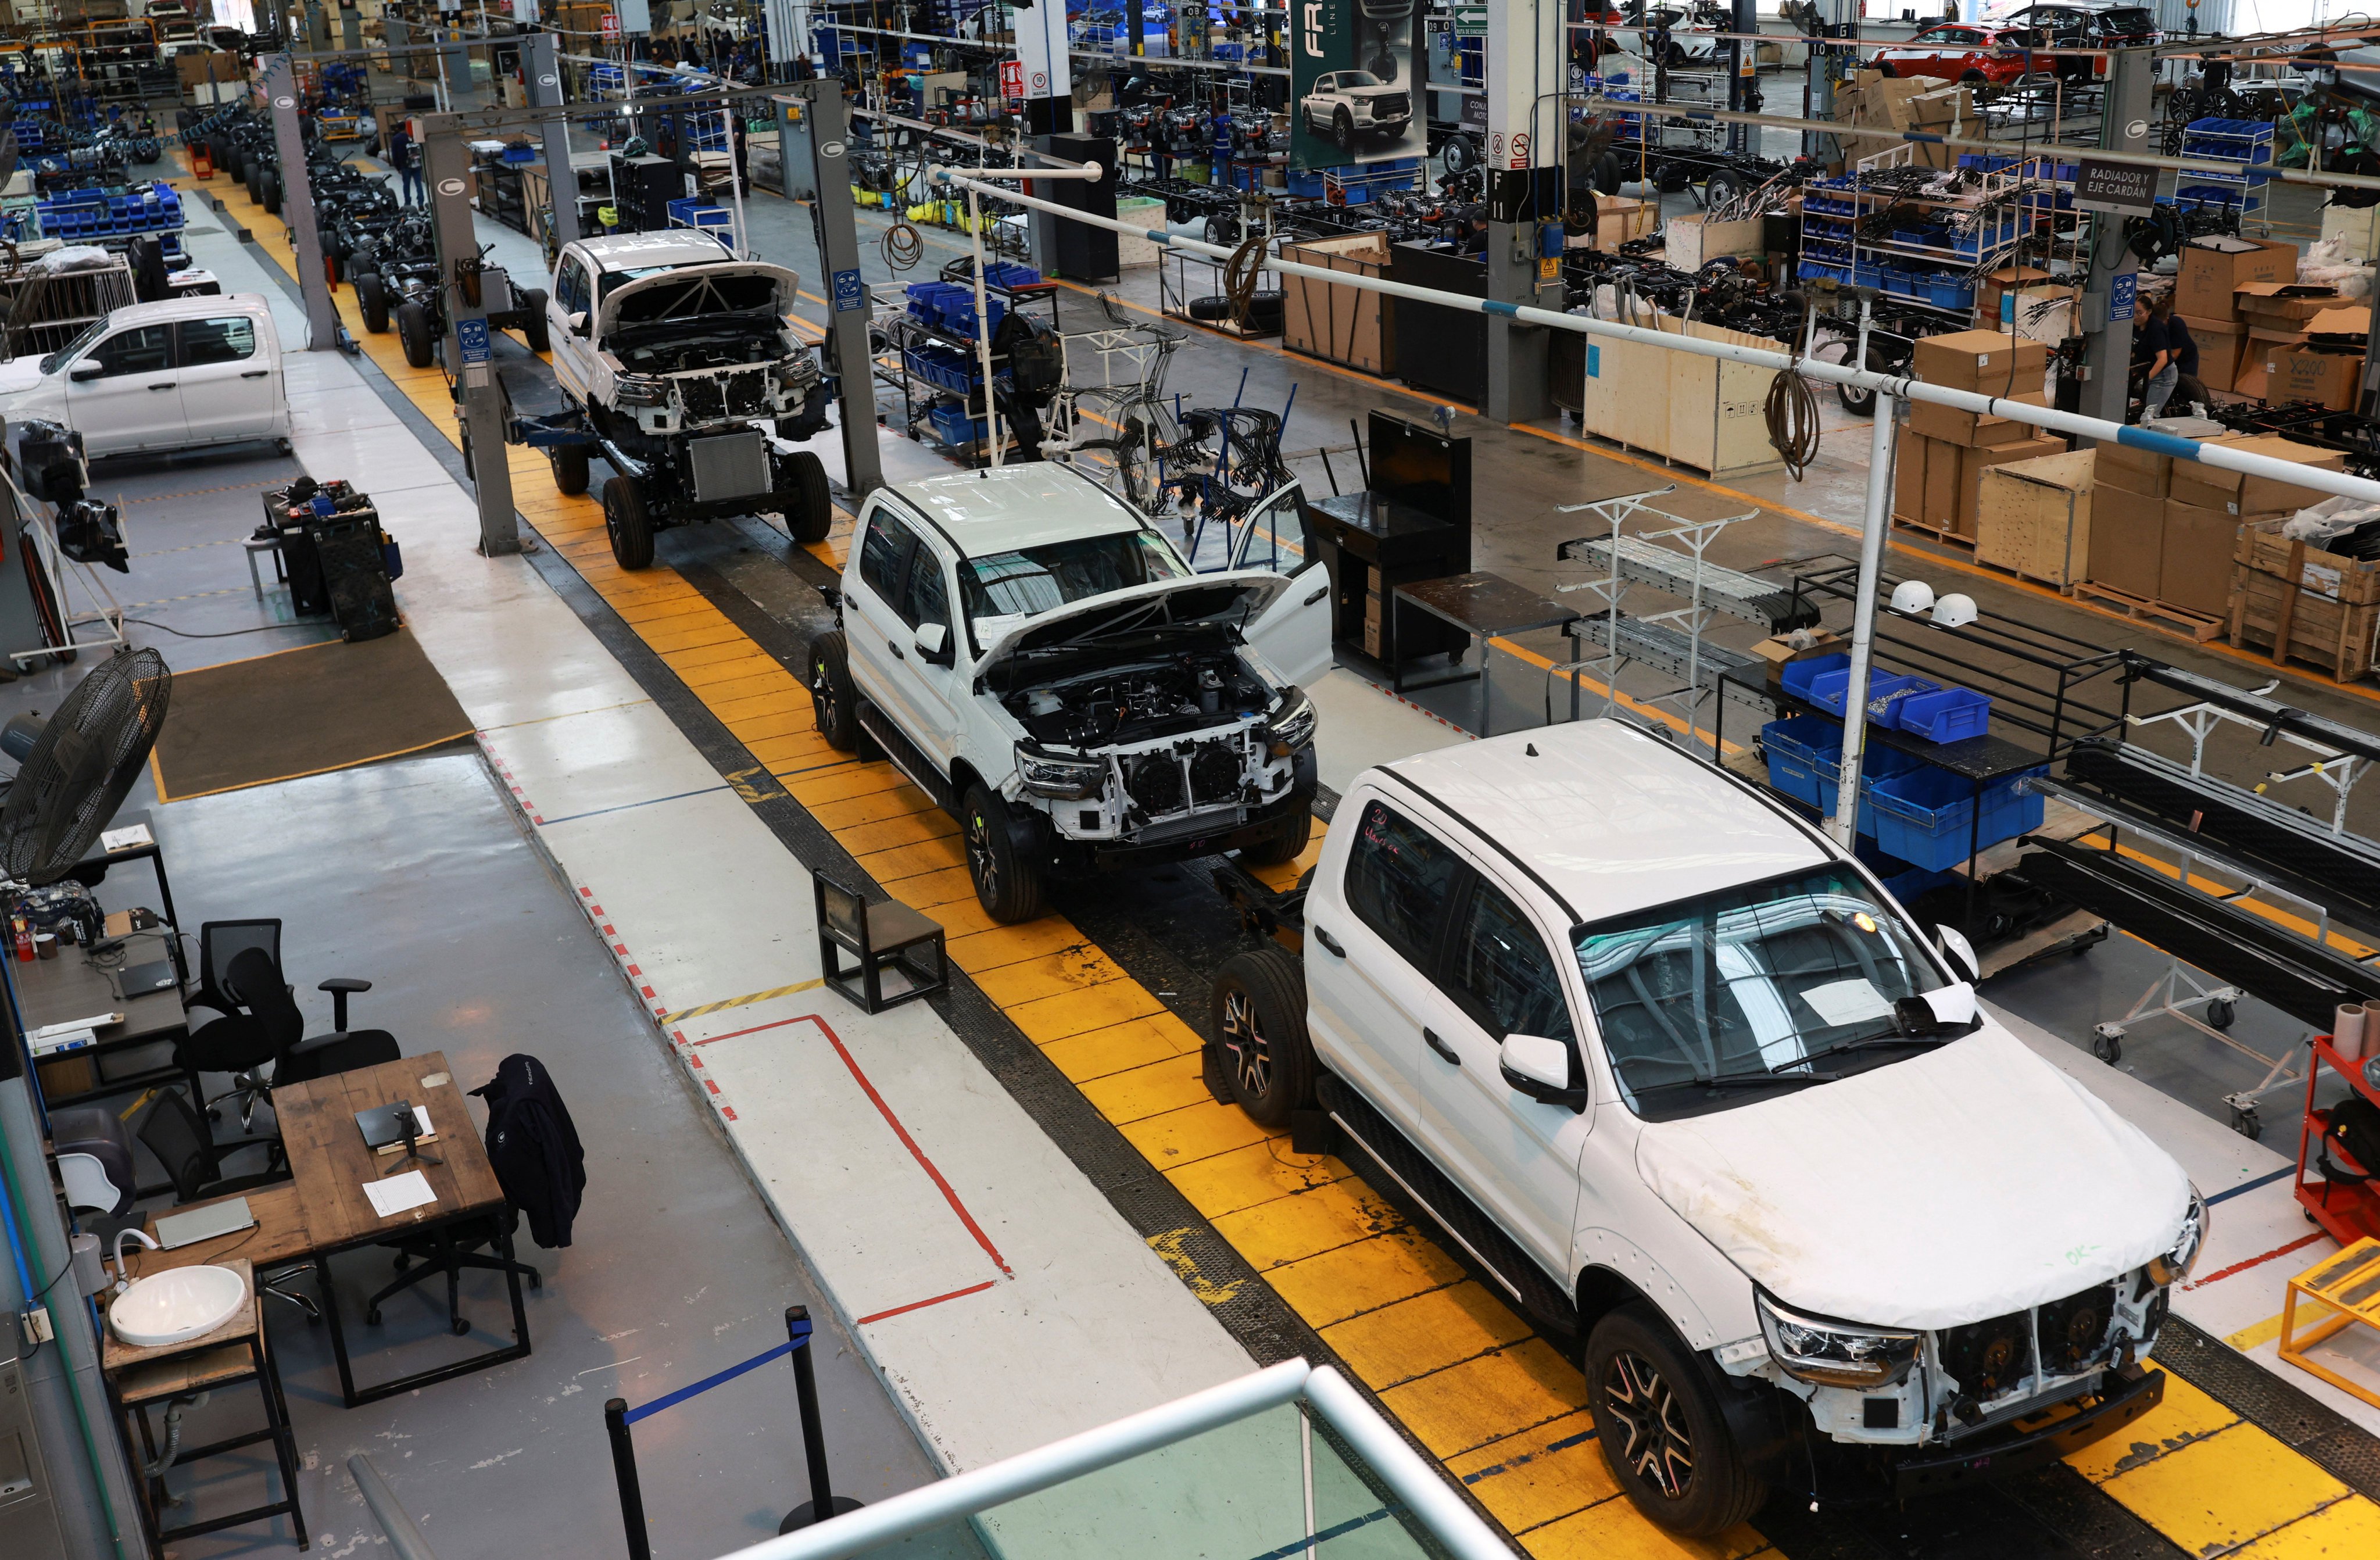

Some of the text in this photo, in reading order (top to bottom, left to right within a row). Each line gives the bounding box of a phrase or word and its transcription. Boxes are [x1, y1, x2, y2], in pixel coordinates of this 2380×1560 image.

[1304, 0, 1324, 58] FR
[1429, 22, 1437, 31] 09
[1814, 44, 1825, 55] 10
[1023, 100, 1027, 113] F
[1023, 120, 1031, 134] 10
[1494, 171, 1501, 189] F
[2090, 168, 2149, 184] RADIADOR Y
[2087, 181, 2146, 198] EJE CARDÁN
[1493, 201, 1503, 220] 11
[2289, 357, 2326, 376] X200
[1372, 809, 1387, 825] 20
